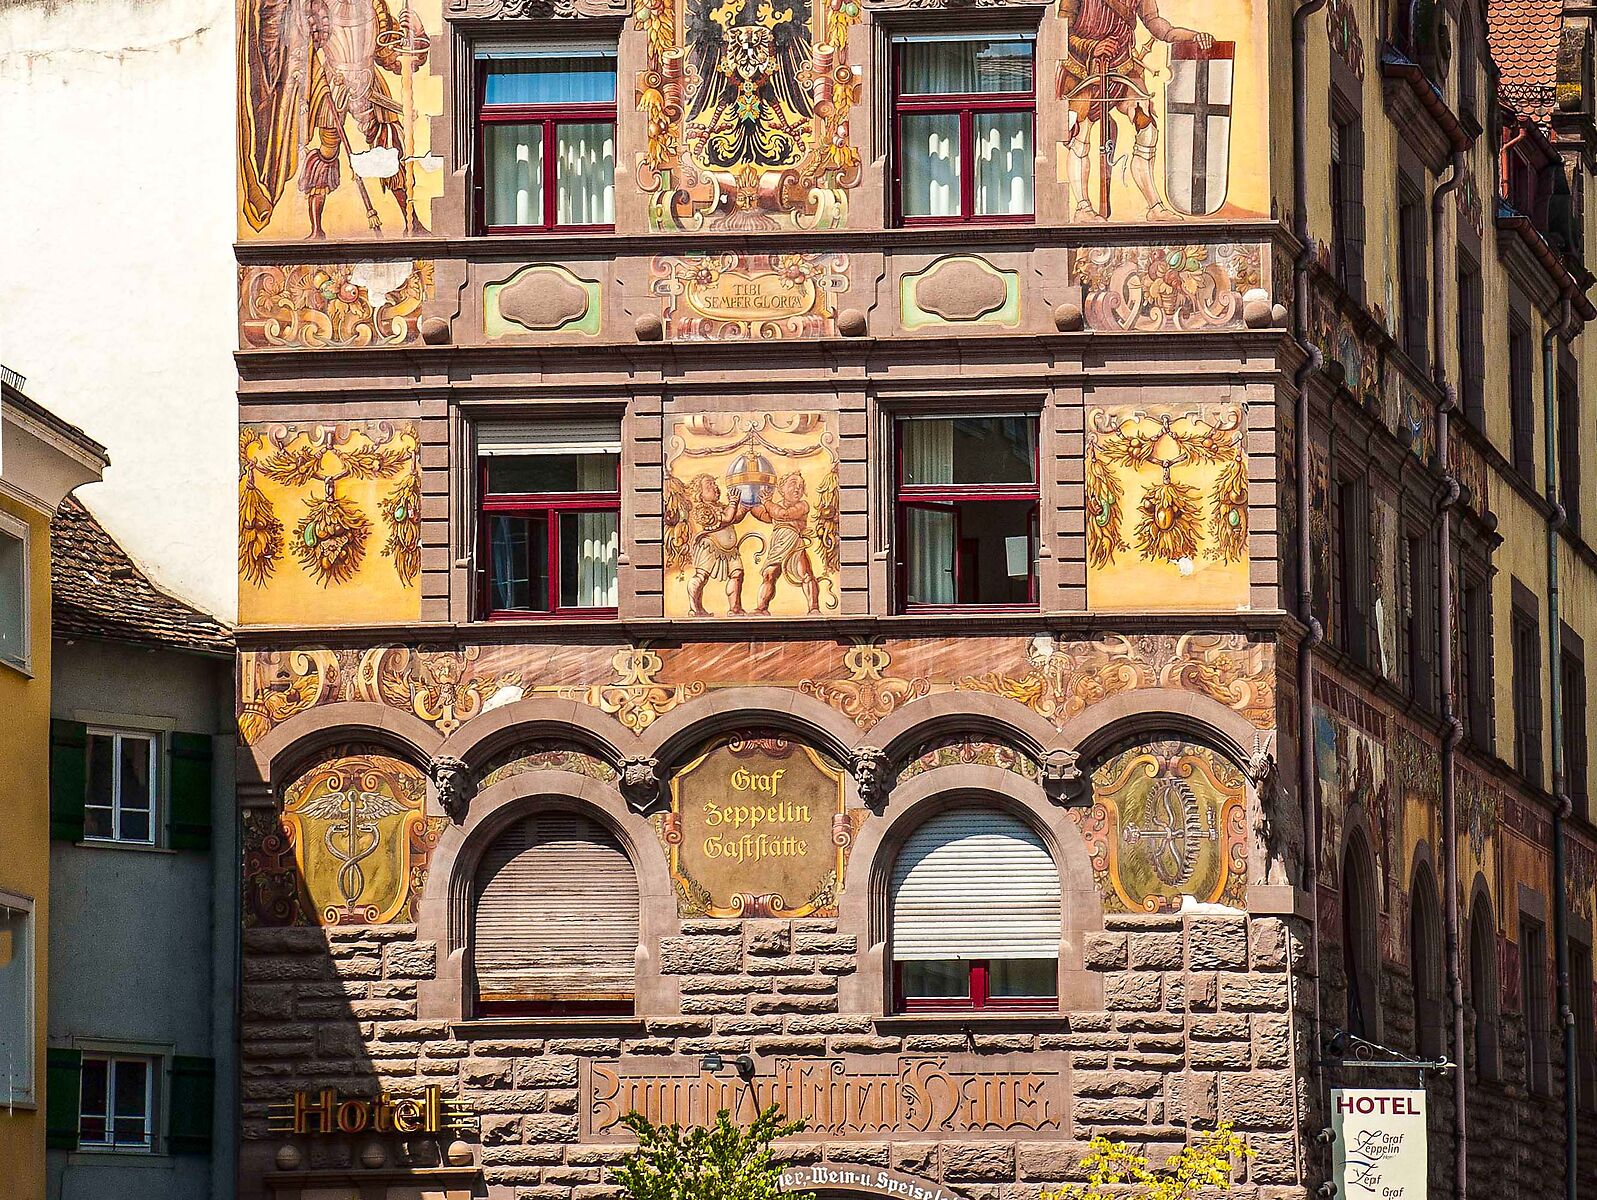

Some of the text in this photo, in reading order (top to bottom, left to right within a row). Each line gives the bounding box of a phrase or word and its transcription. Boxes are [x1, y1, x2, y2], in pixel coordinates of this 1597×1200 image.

[704, 295, 803, 309] SEMPER GLORIA
[732, 284, 762, 296] TIBI
[730, 765, 787, 798] Graf
[702, 799, 812, 830] Zeppelin
[900, 1057, 1061, 1132] Haus
[1336, 1096, 1421, 1115] HOTEL
[294, 1084, 441, 1133] Hotel
[1349, 1130, 1400, 1160] Zeppelin
[1382, 1133, 1405, 1144] Graf
[1382, 1186, 1405, 1198] Graf
